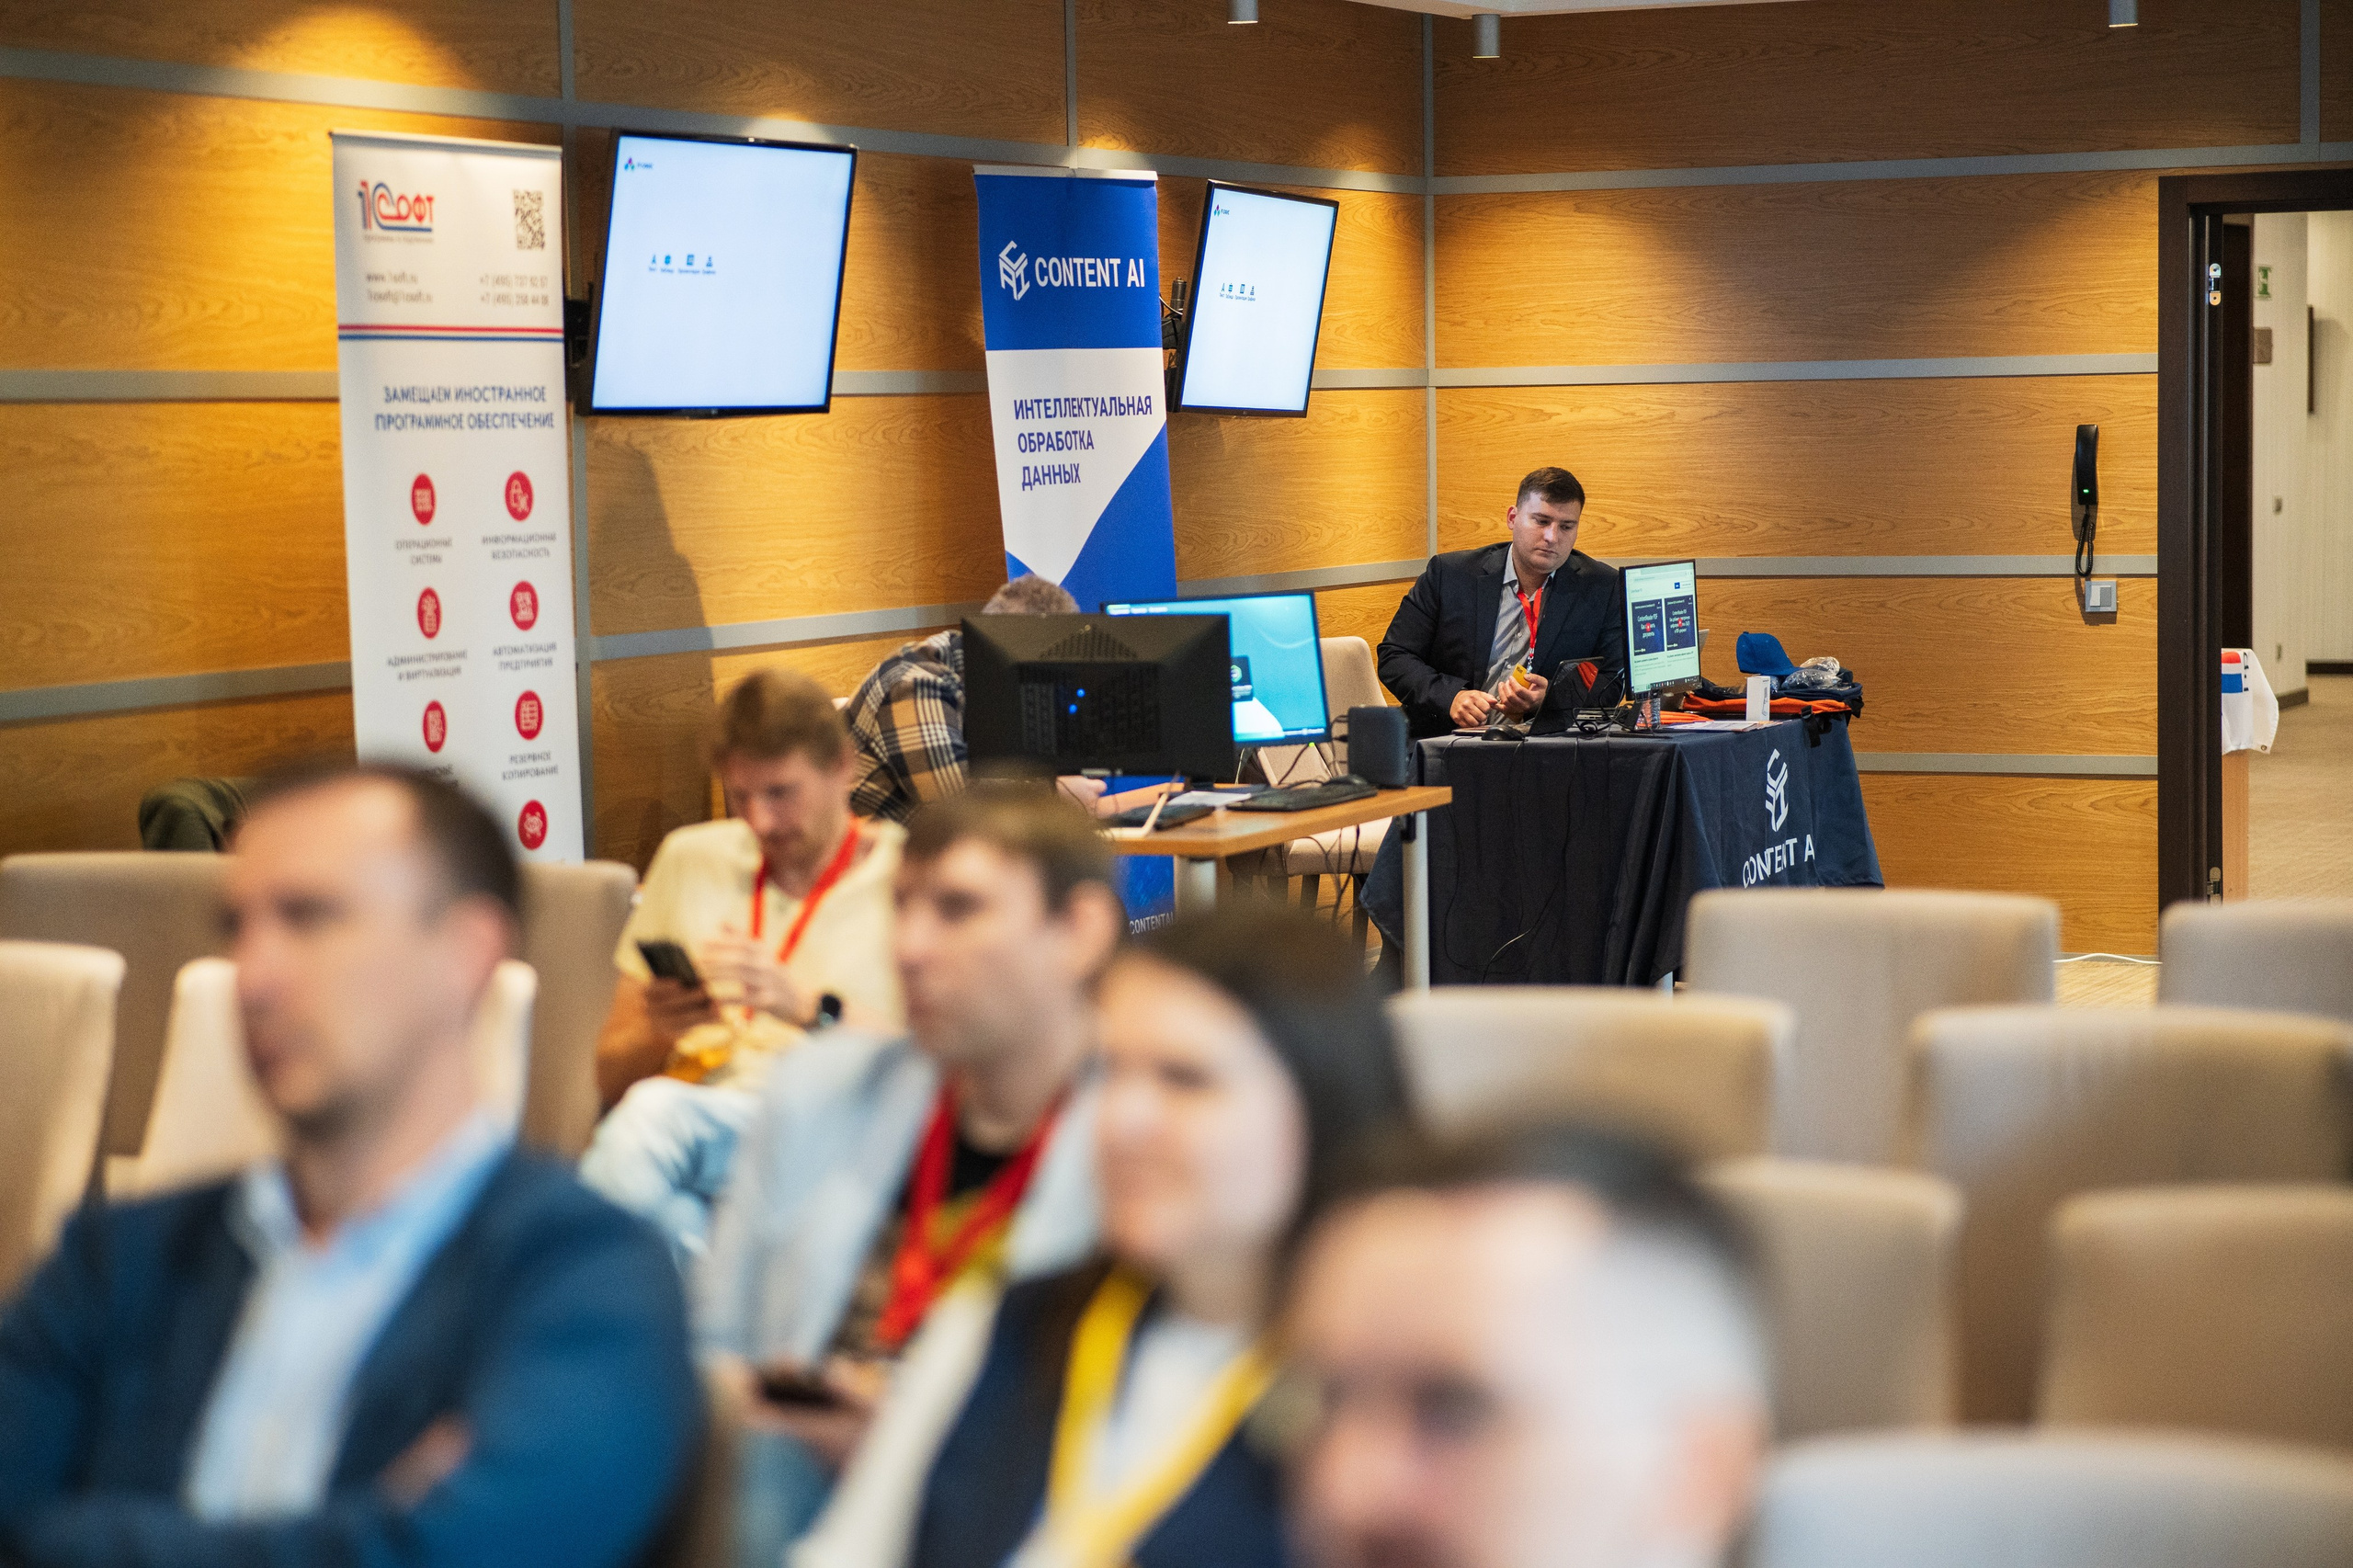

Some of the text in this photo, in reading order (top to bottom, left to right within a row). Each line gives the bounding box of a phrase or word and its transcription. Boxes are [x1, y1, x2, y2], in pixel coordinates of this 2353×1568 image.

[1035, 256, 1145, 288] CONTENT AI
[383, 386, 547, 403] ЗАМЕЩАЕМ ИНОСТРАННОЕ
[1014, 395, 1153, 420] ИНТЕЛЛЕКТУАЛЬНАЯ
[374, 412, 555, 431] ПРОГРАММНОЕ ОБЕСПЕЧЕНИЕ
[1017, 430, 1095, 453] ОБРАБОТКА
[1022, 463, 1081, 492] ДАННЫХ
